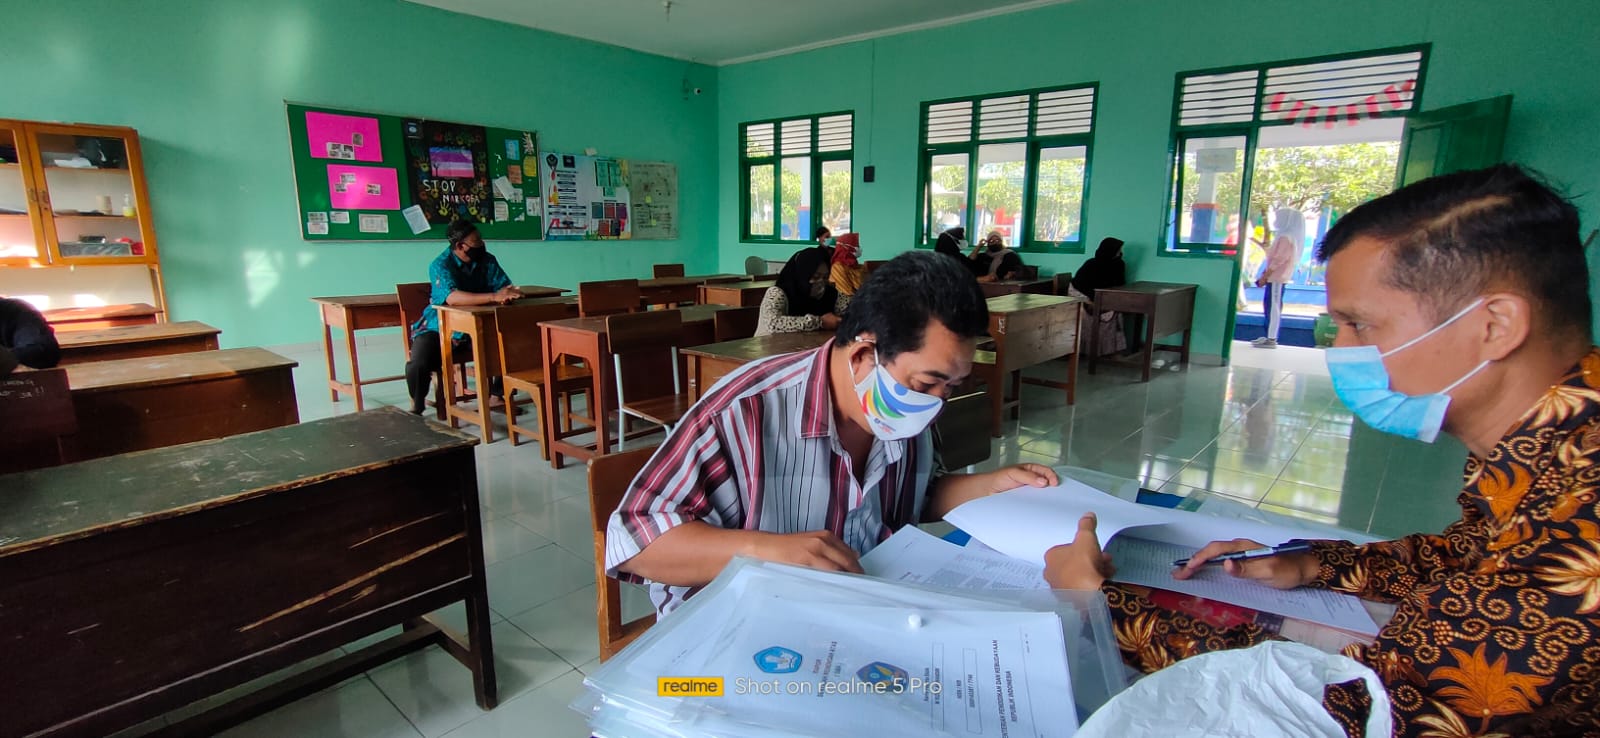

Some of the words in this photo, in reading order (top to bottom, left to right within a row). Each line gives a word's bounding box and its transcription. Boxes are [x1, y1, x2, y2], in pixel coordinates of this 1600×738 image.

[422, 179, 456, 192] STOP
[992, 639, 1001, 674] KEBUDAYAAN
[1005, 671, 1014, 698] INDONESIA
[996, 685, 1005, 715] PENDIDIKAN
